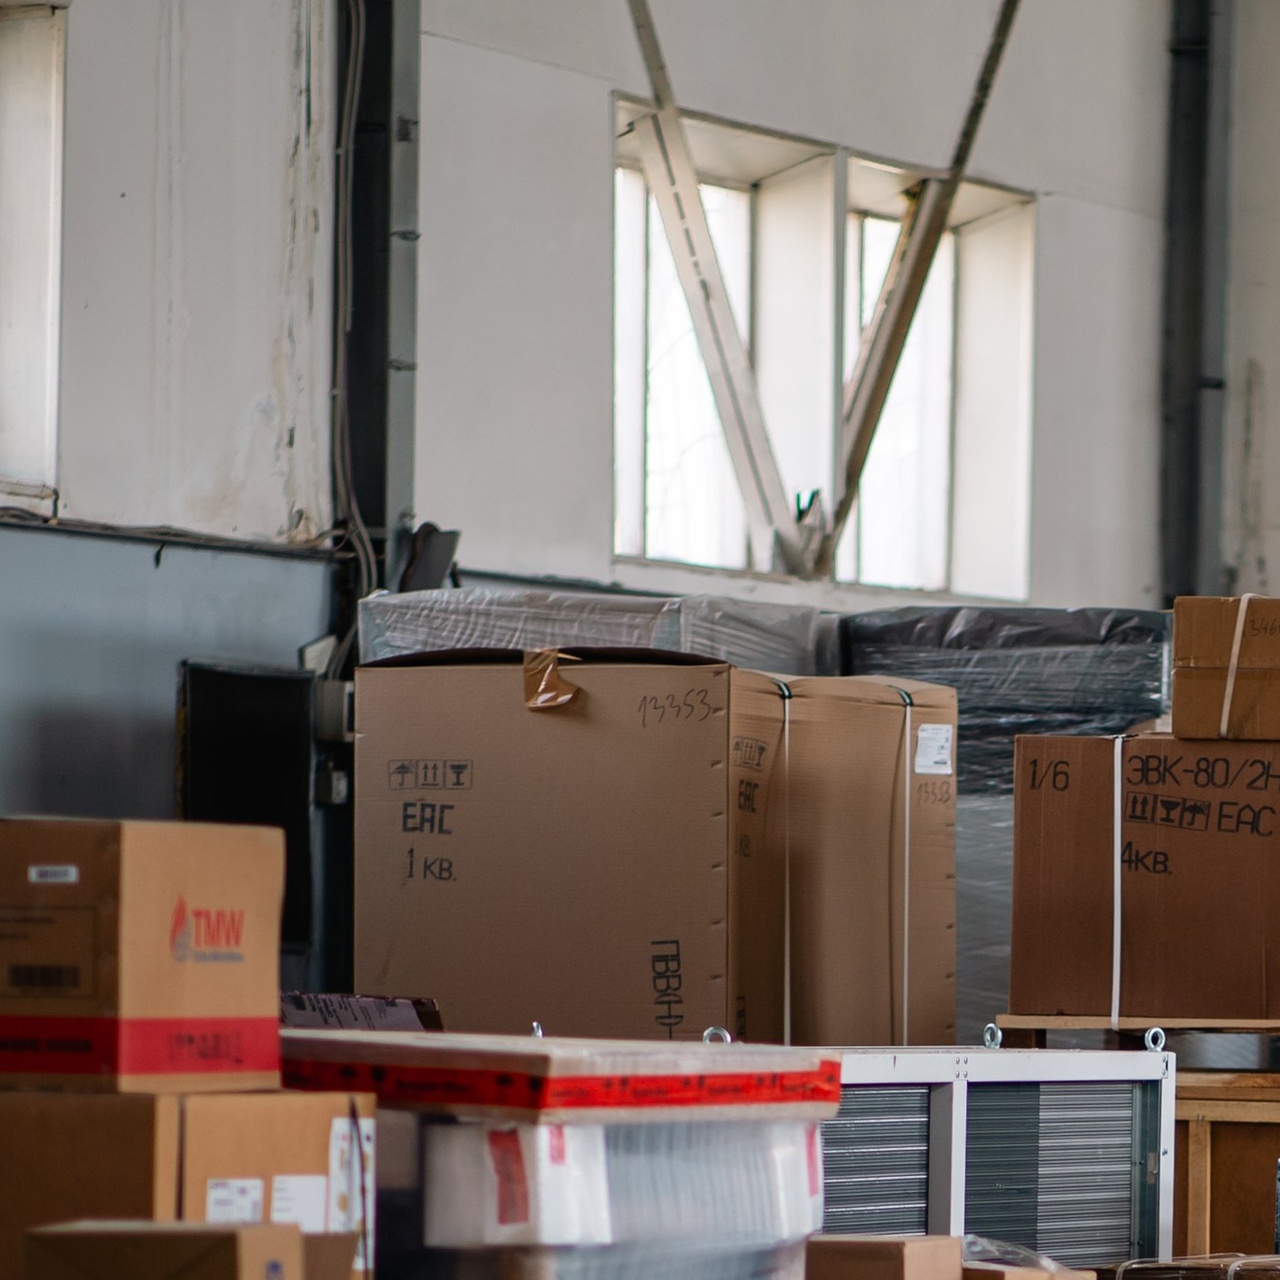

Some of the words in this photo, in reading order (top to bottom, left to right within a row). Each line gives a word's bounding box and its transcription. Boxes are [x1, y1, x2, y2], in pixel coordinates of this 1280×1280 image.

[1029, 758, 1070, 792] 1/6
[401, 802, 454, 835] EAC
[1217, 801, 1277, 837] EAC
[192, 909, 245, 947] TMW
